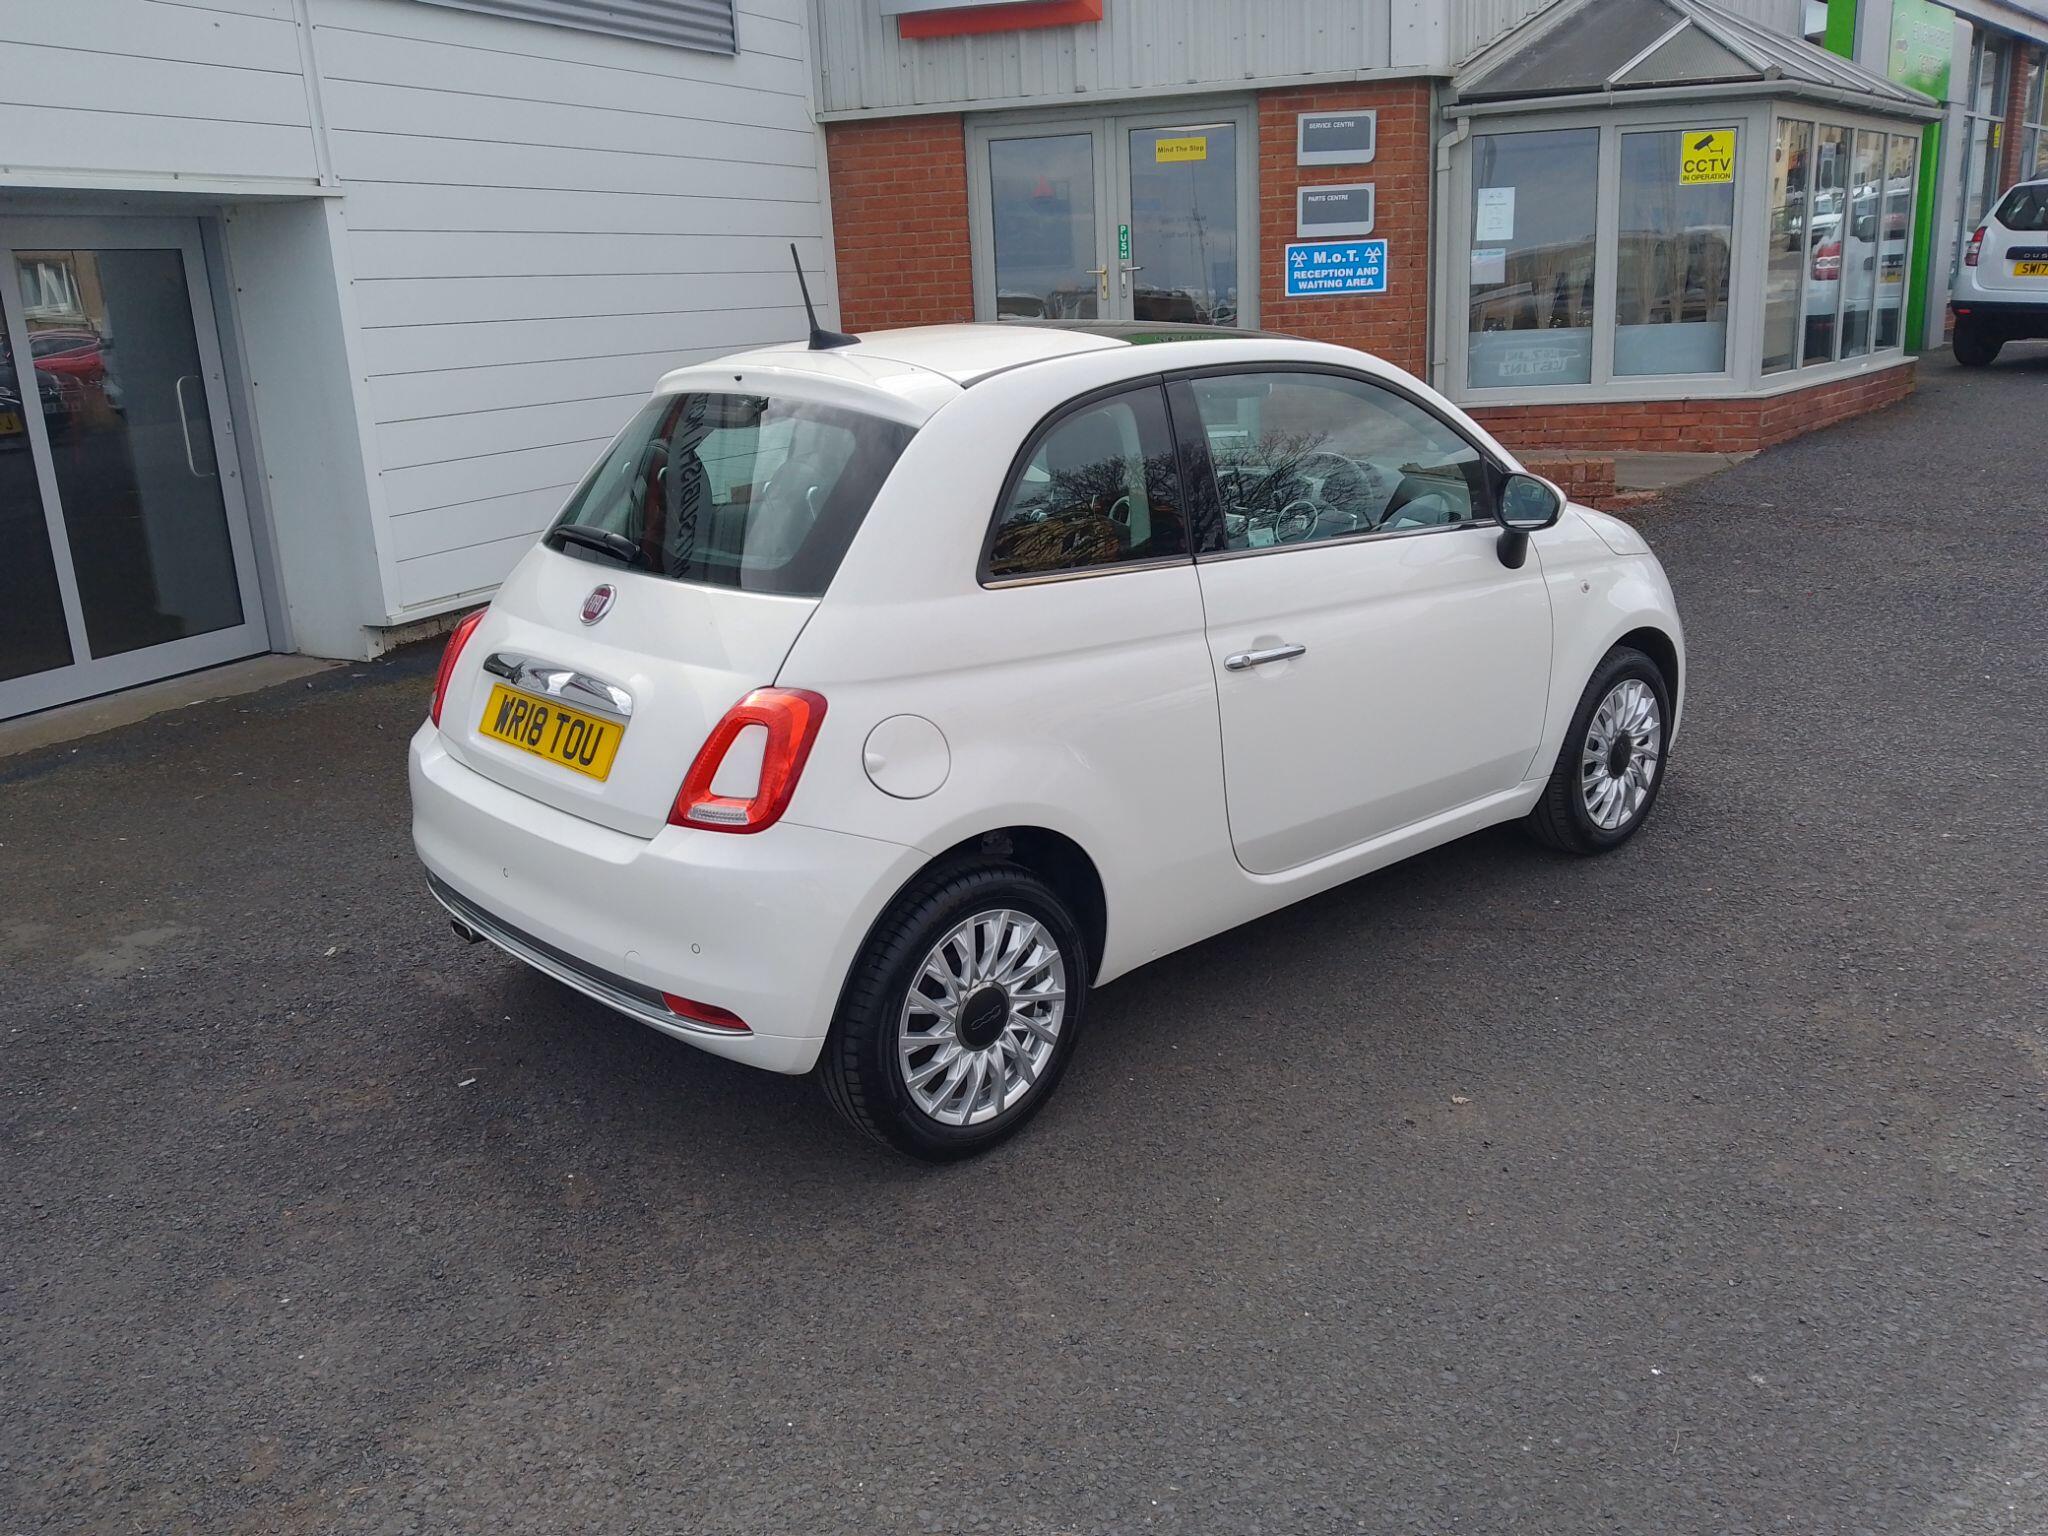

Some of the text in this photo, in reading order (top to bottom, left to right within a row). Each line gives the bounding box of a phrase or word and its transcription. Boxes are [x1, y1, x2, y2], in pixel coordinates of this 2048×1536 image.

[1309, 121, 1332, 129] SERVICE
[1683, 158, 1731, 173] CCTV
[1691, 173, 1731, 181] OPERATION
[1120, 225, 1128, 259] PUSH
[1313, 249, 1360, 264] M.o.T.
[1294, 266, 1379, 280] RECEPTION AND
[2022, 263, 2048, 274] SW17
[1298, 277, 1374, 290] WAITING AREA
[585, 594, 608, 614] FIAT
[493, 694, 605, 767] WR18 TOU
